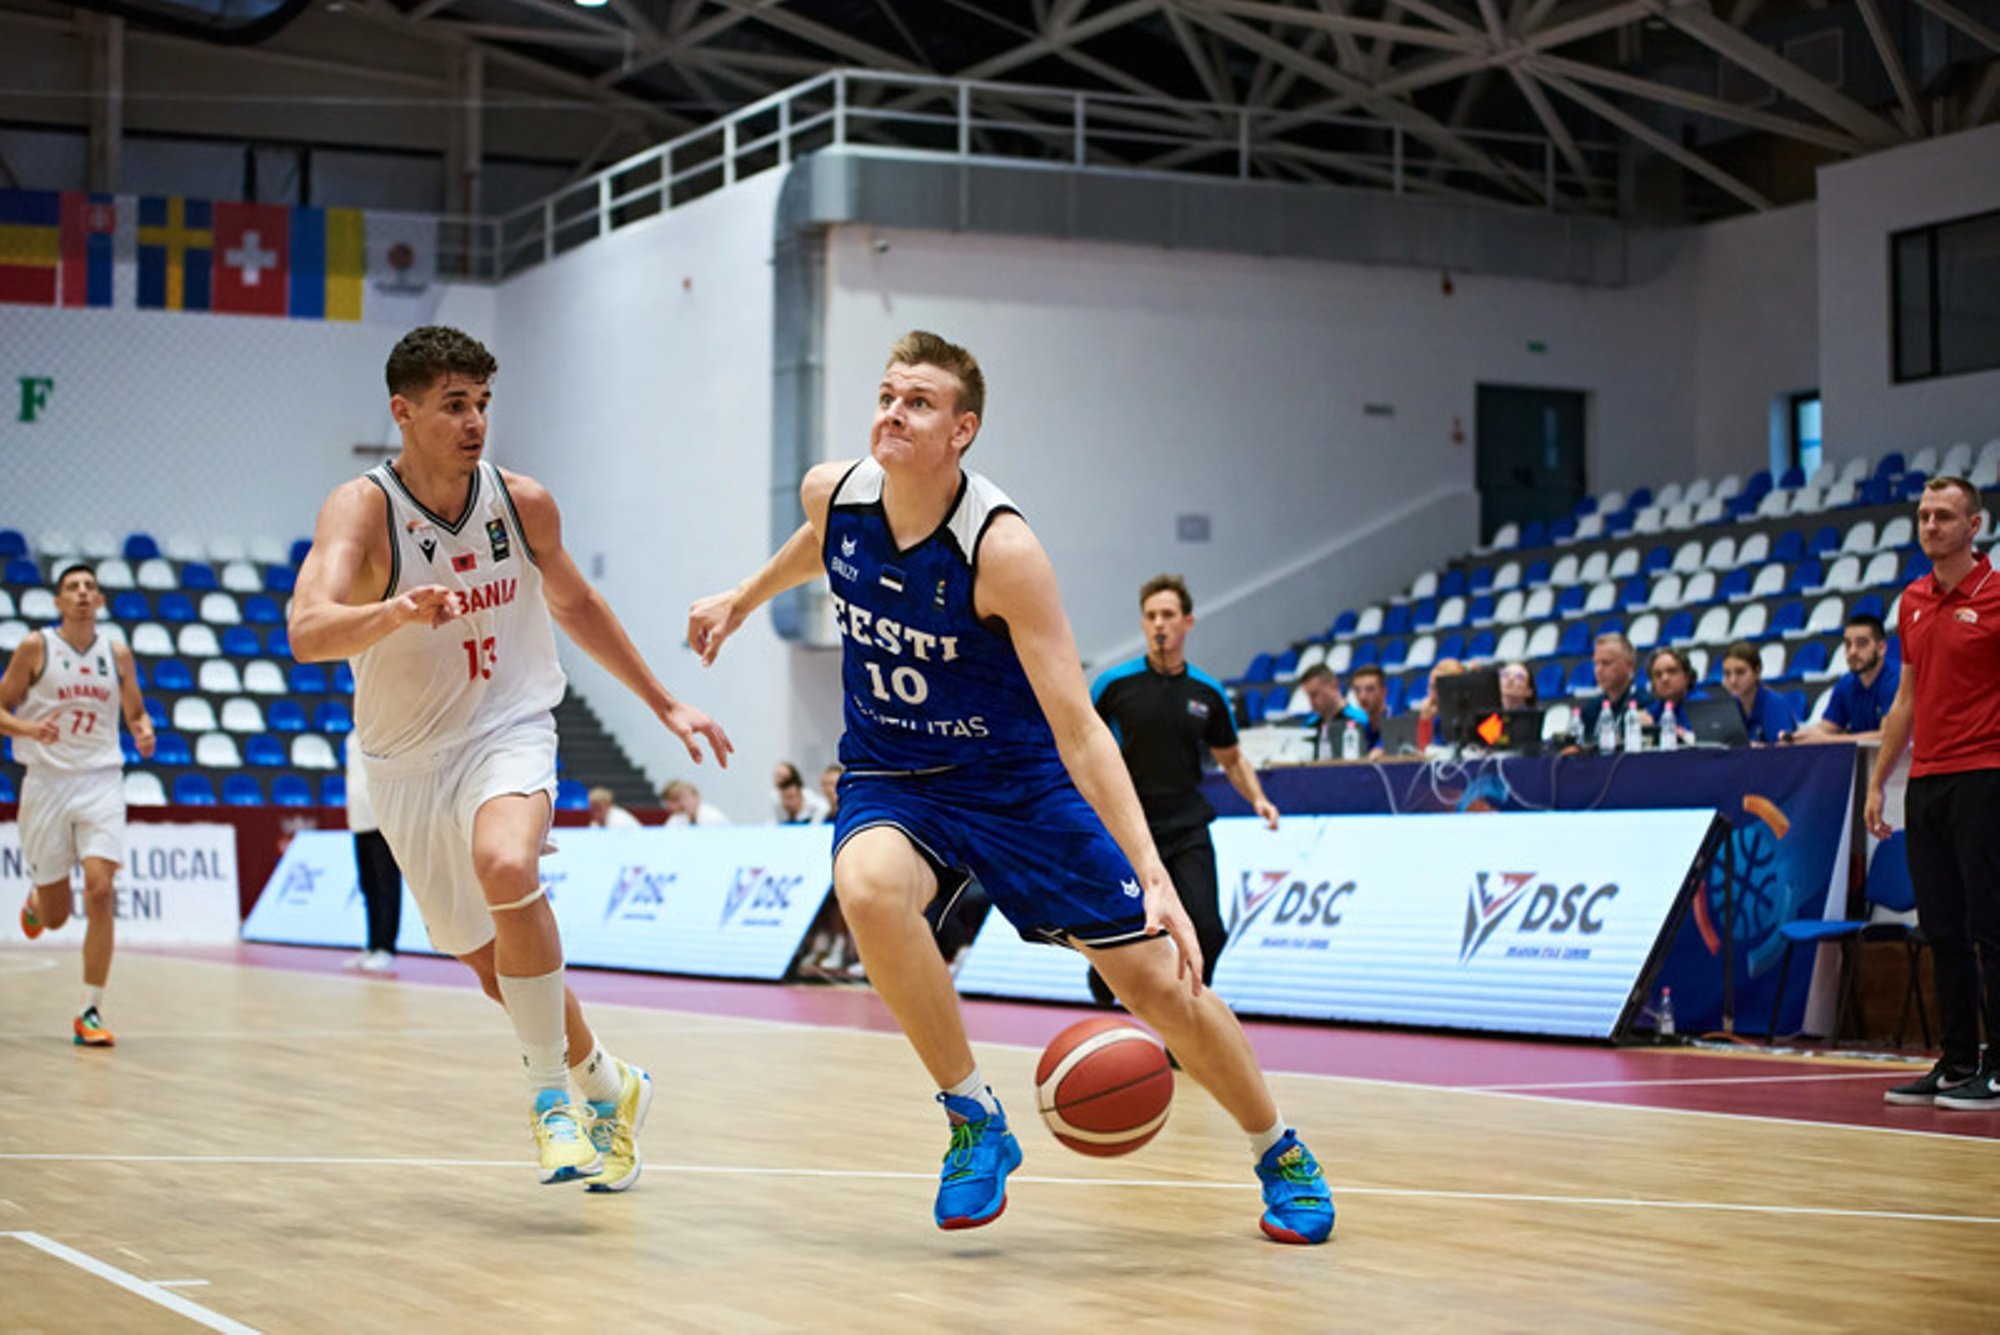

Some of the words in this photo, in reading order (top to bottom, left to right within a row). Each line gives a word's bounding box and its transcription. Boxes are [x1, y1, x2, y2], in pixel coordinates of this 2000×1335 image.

[17, 376, 54, 423] F
[831, 592, 959, 662] EESTI
[865, 662, 928, 705] 10
[71, 709, 97, 735] 77
[131, 848, 226, 881] LOCAL
[1272, 881, 1357, 926] DSC
[1518, 883, 1620, 934] DSC
